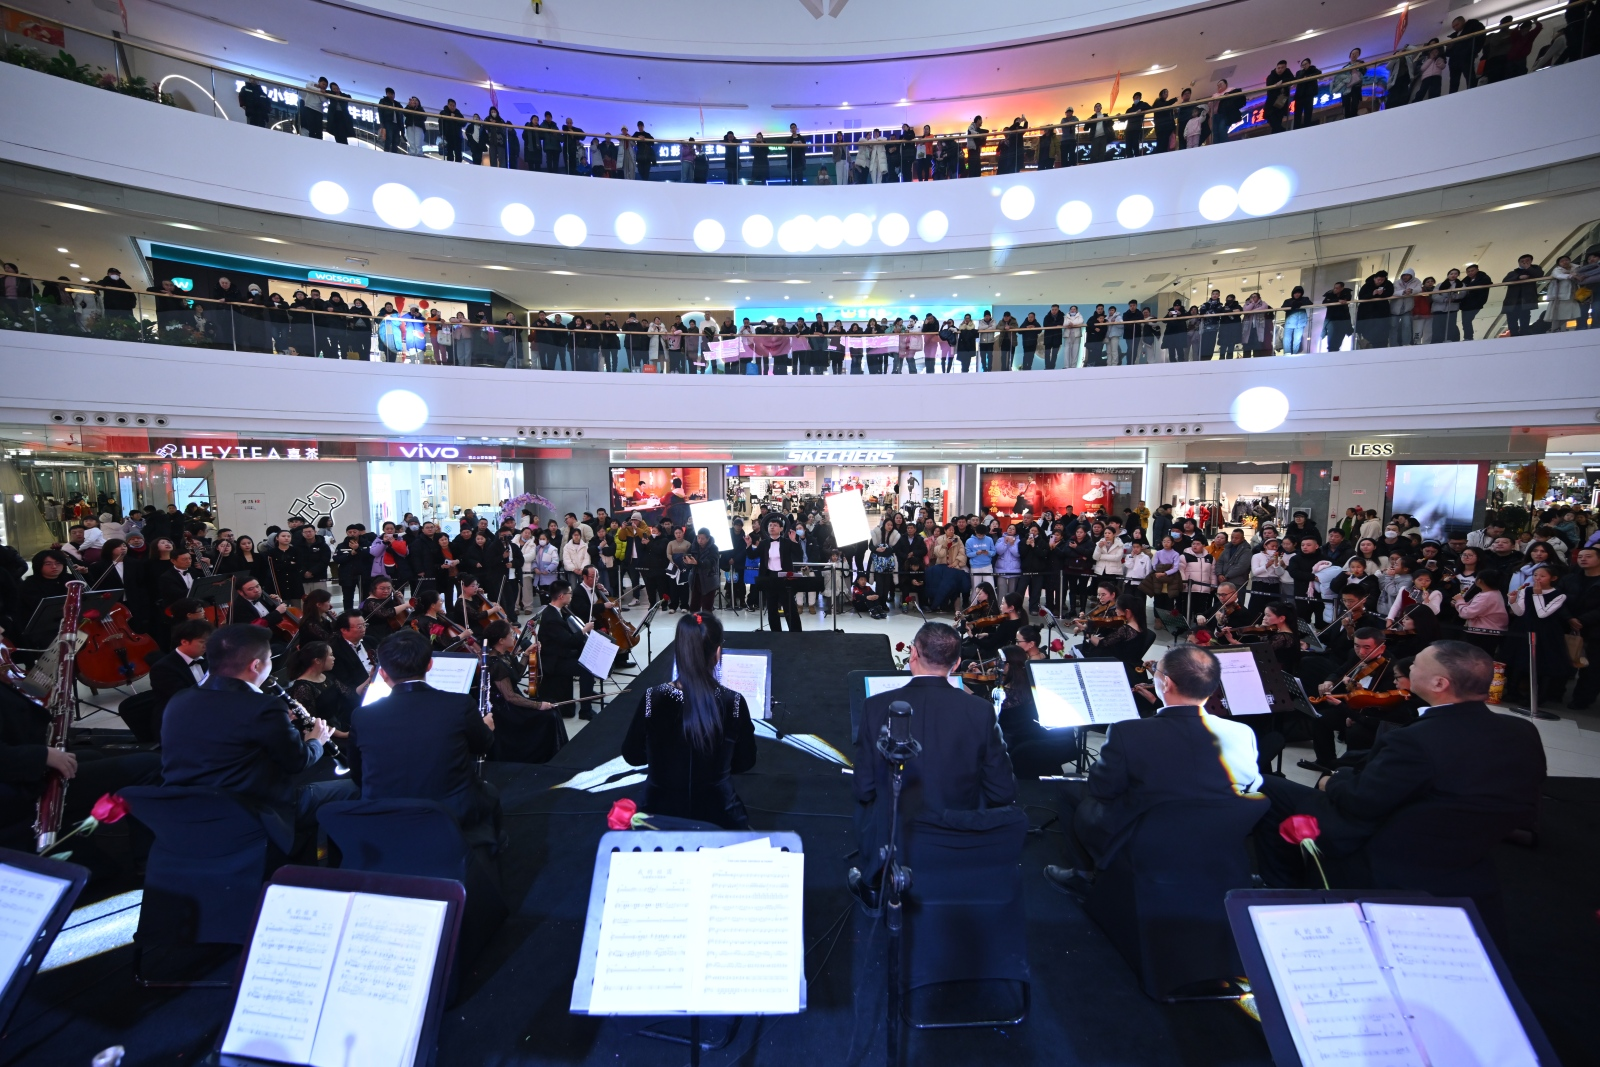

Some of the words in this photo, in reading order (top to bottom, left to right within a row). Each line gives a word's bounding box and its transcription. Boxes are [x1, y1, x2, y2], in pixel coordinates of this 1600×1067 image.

[315, 272, 362, 285] watsons
[182, 445, 281, 460] HEYTEA
[287, 447, 319, 460] 喜茶
[399, 443, 459, 458] vivo
[786, 450, 896, 462] SKECHERS
[1350, 444, 1394, 457] LESS
